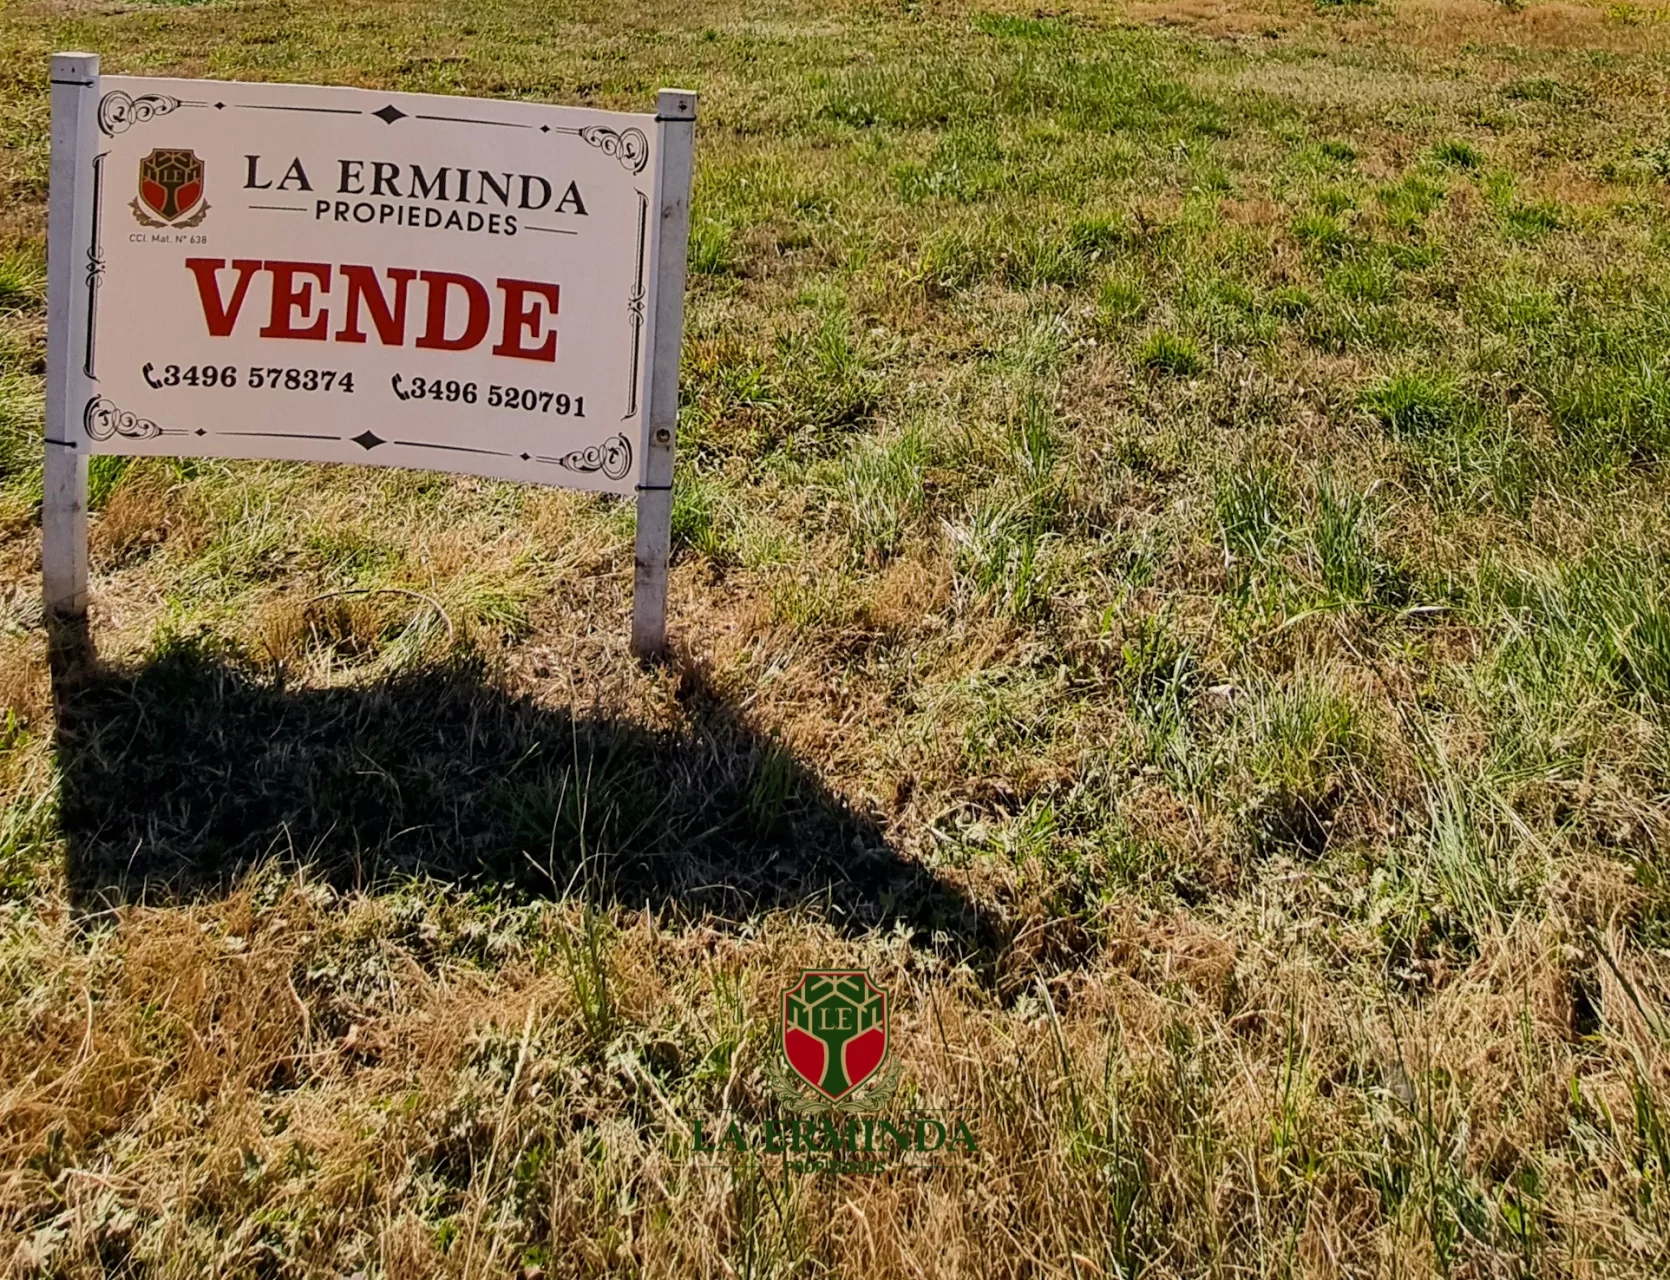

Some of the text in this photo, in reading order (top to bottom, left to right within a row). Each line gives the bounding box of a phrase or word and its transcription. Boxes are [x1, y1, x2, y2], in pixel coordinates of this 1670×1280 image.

[244, 154, 589, 216] LA ERMINDA
[315, 200, 518, 237] PROPIEDADES
[152, 234, 172, 244] Mat.
[190, 235, 207, 244] 638
[185, 257, 560, 363] VENDE
[163, 366, 355, 394] 3496 578374
[410, 378, 587, 418] 3496 520791
